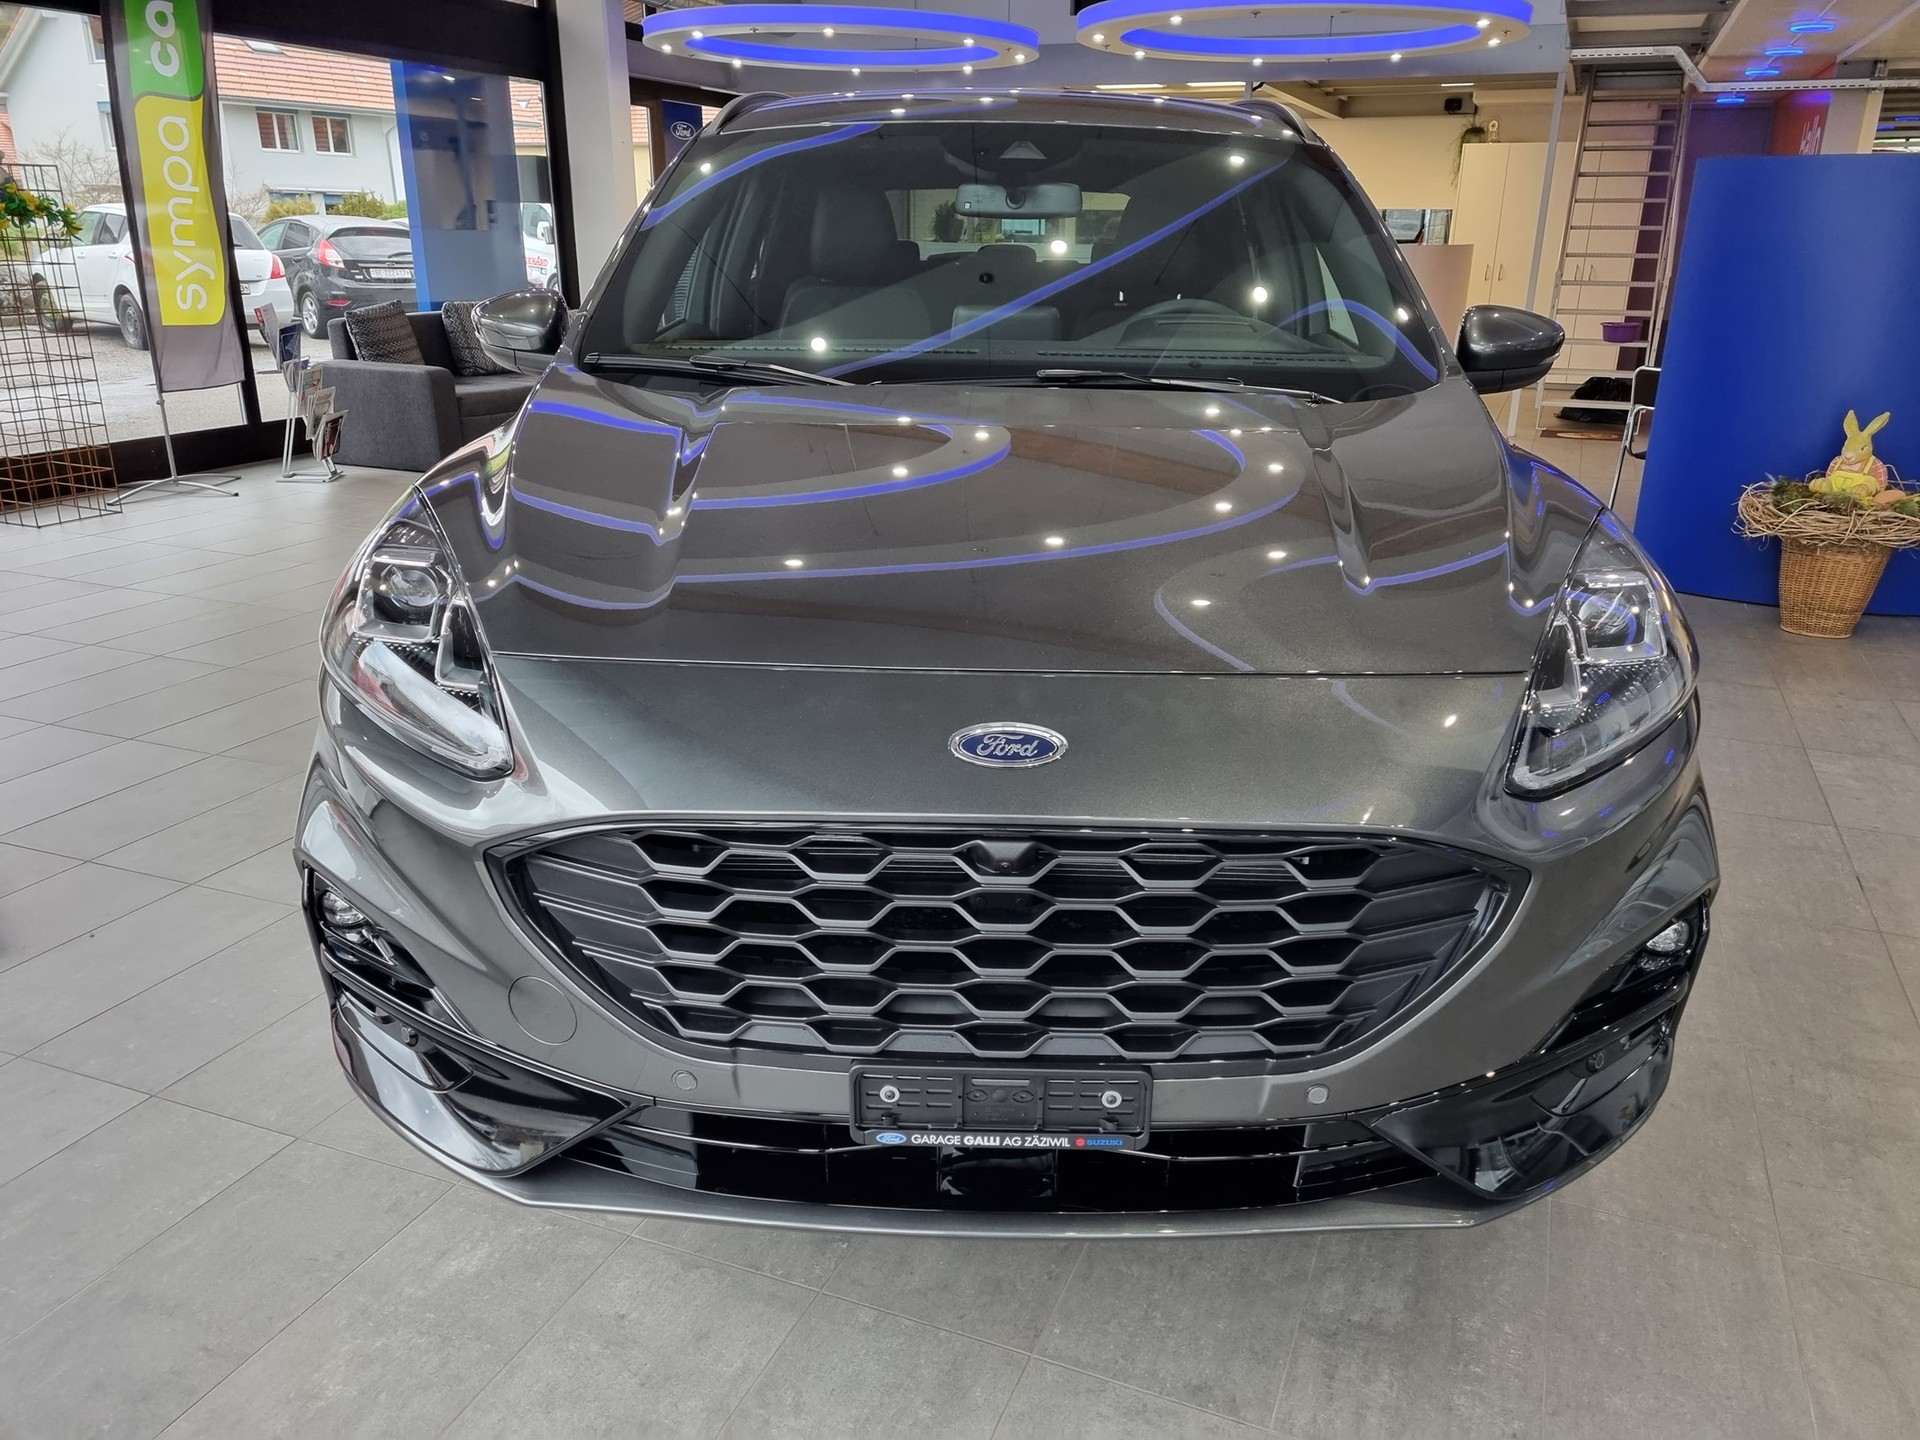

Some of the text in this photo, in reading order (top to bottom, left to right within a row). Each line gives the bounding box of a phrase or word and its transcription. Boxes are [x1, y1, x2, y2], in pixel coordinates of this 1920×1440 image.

[675, 123, 692, 138] Ford
[158, 115, 216, 310] sympa
[976, 733, 1039, 757] Ford
[911, 1134, 1071, 1147] GARAGE GALLI AG ZÄZIWIL
[1086, 1138, 1124, 1146] SUZUKI
